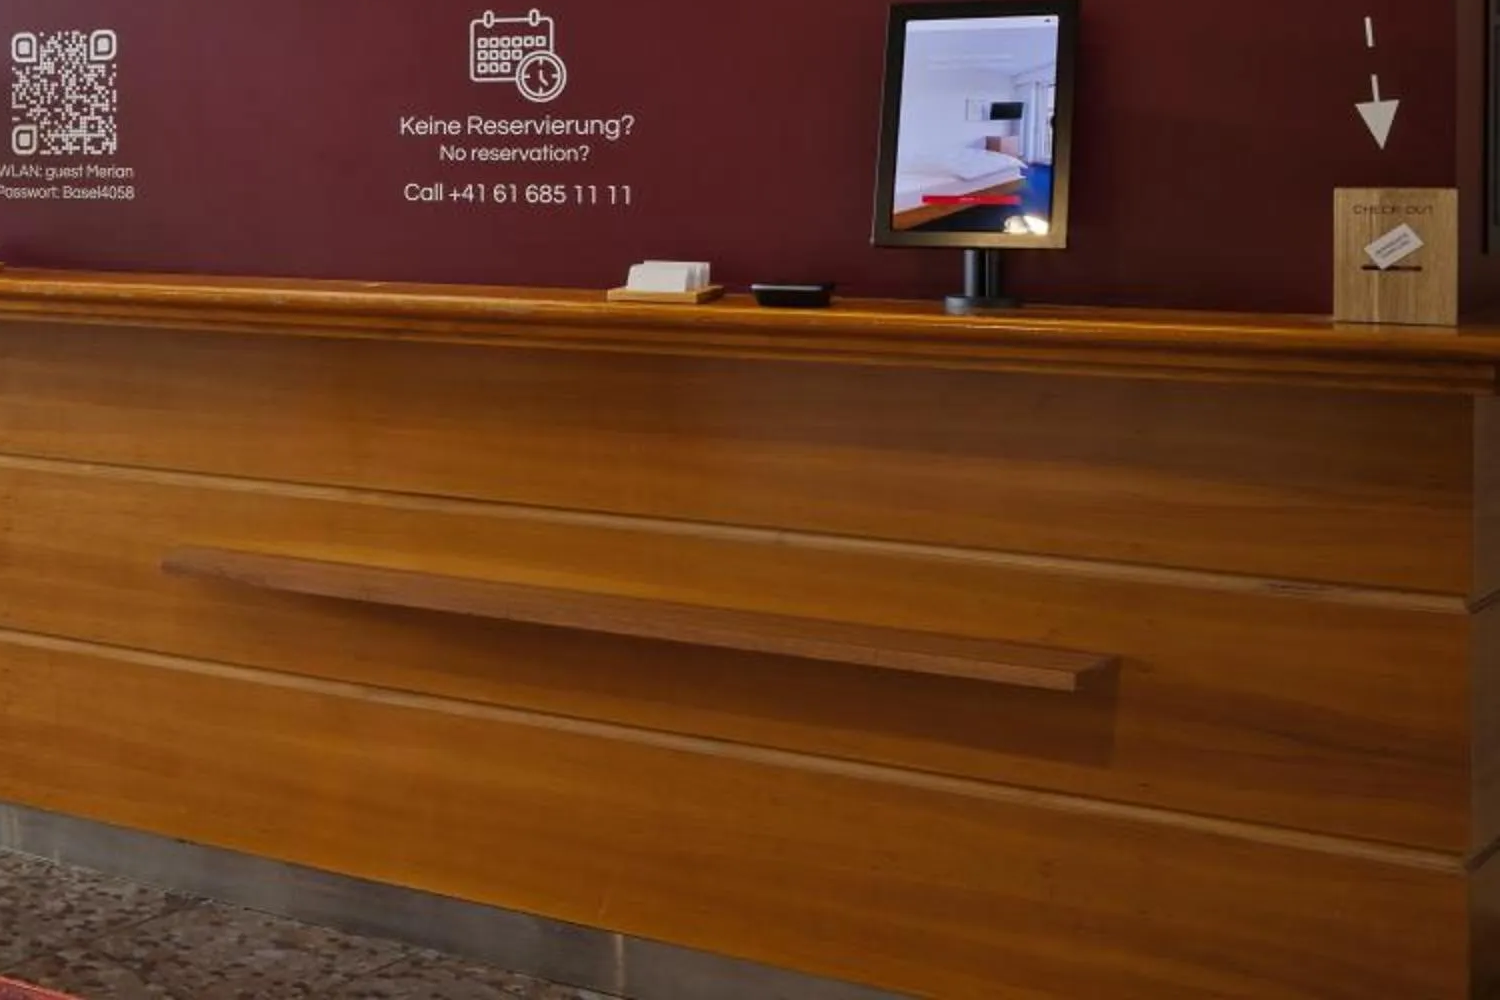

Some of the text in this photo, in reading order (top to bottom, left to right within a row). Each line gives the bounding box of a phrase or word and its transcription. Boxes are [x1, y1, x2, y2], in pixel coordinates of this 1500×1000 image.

[399, 114, 636, 141] Keine Reservierung?
[439, 144, 591, 162] No reservation?
[45, 163, 83, 181] guest
[86, 164, 135, 178] Merian
[62, 185, 137, 201] Basel4058
[403, 183, 632, 205] Call +41 61 685 11 11
